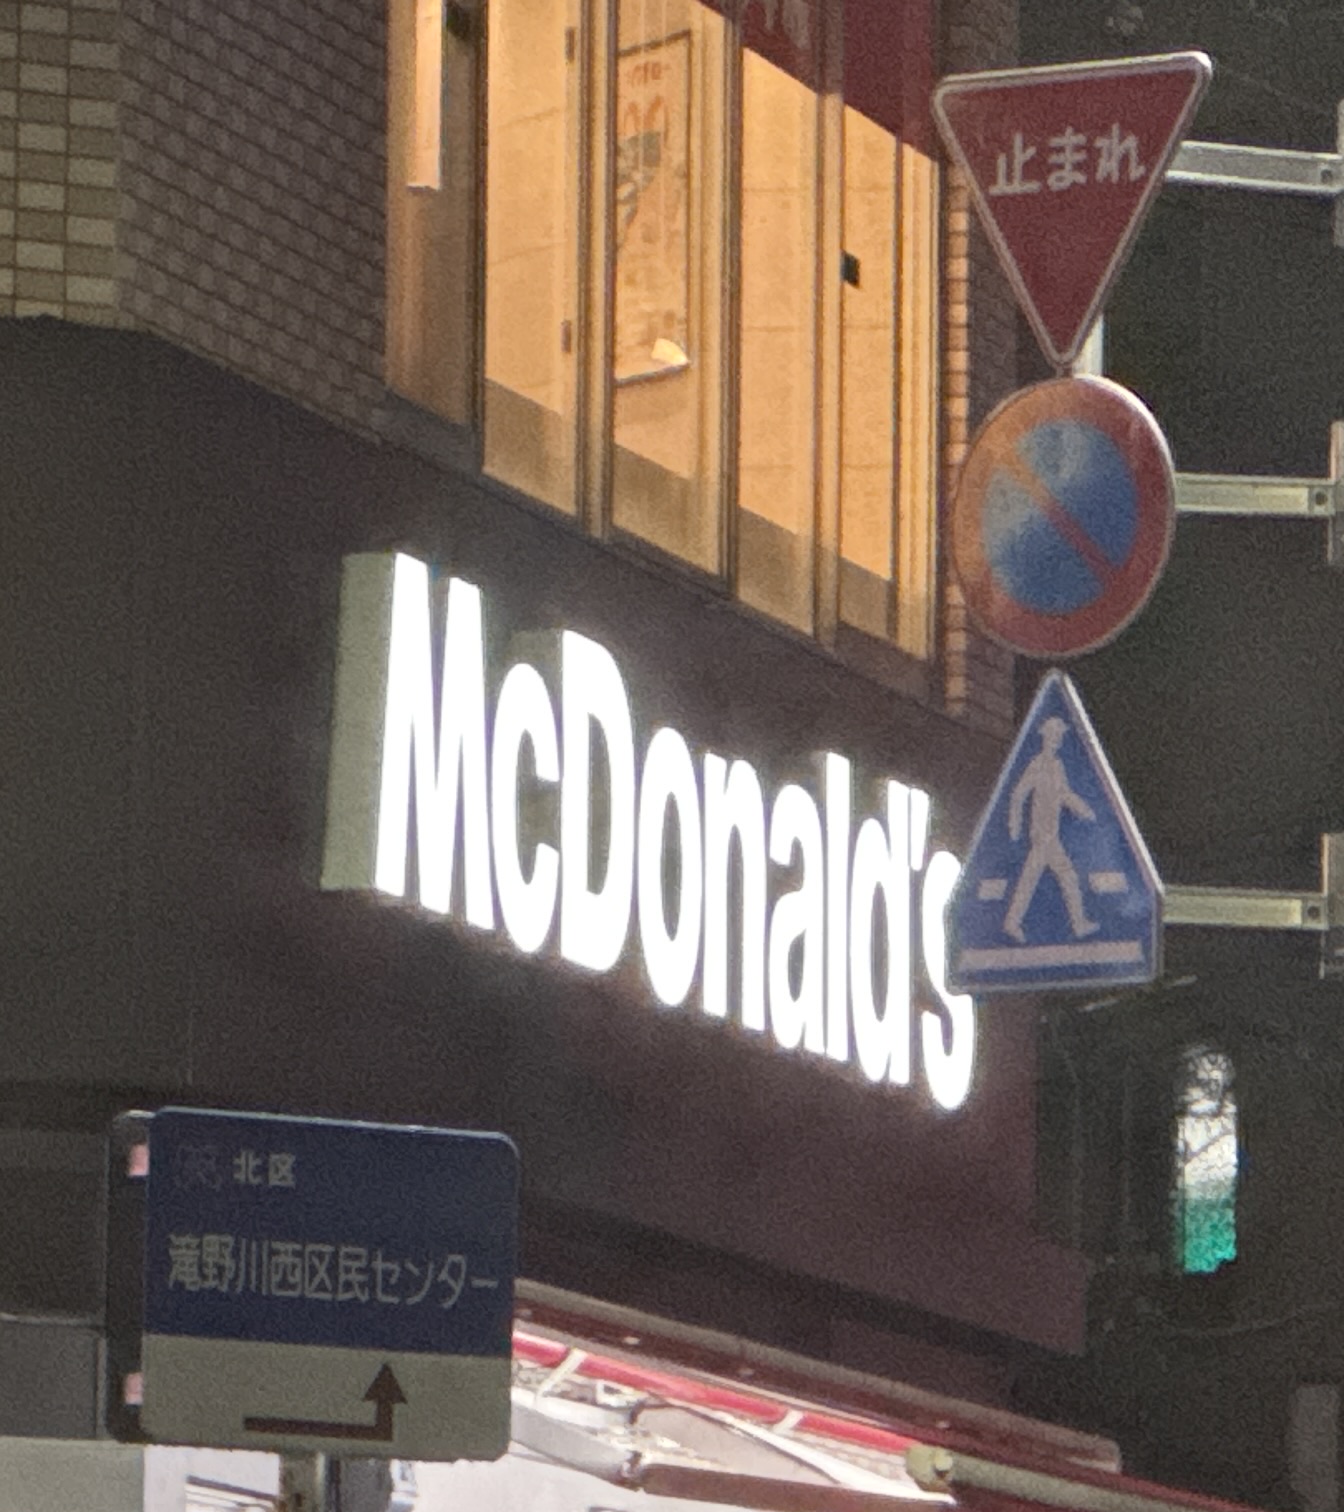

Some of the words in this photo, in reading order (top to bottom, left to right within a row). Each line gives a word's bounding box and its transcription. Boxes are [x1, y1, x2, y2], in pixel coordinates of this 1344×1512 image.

[988, 123, 1146, 196] 止まれ
[372, 551, 975, 1110] McDonald's
[232, 1150, 297, 1189] 北区
